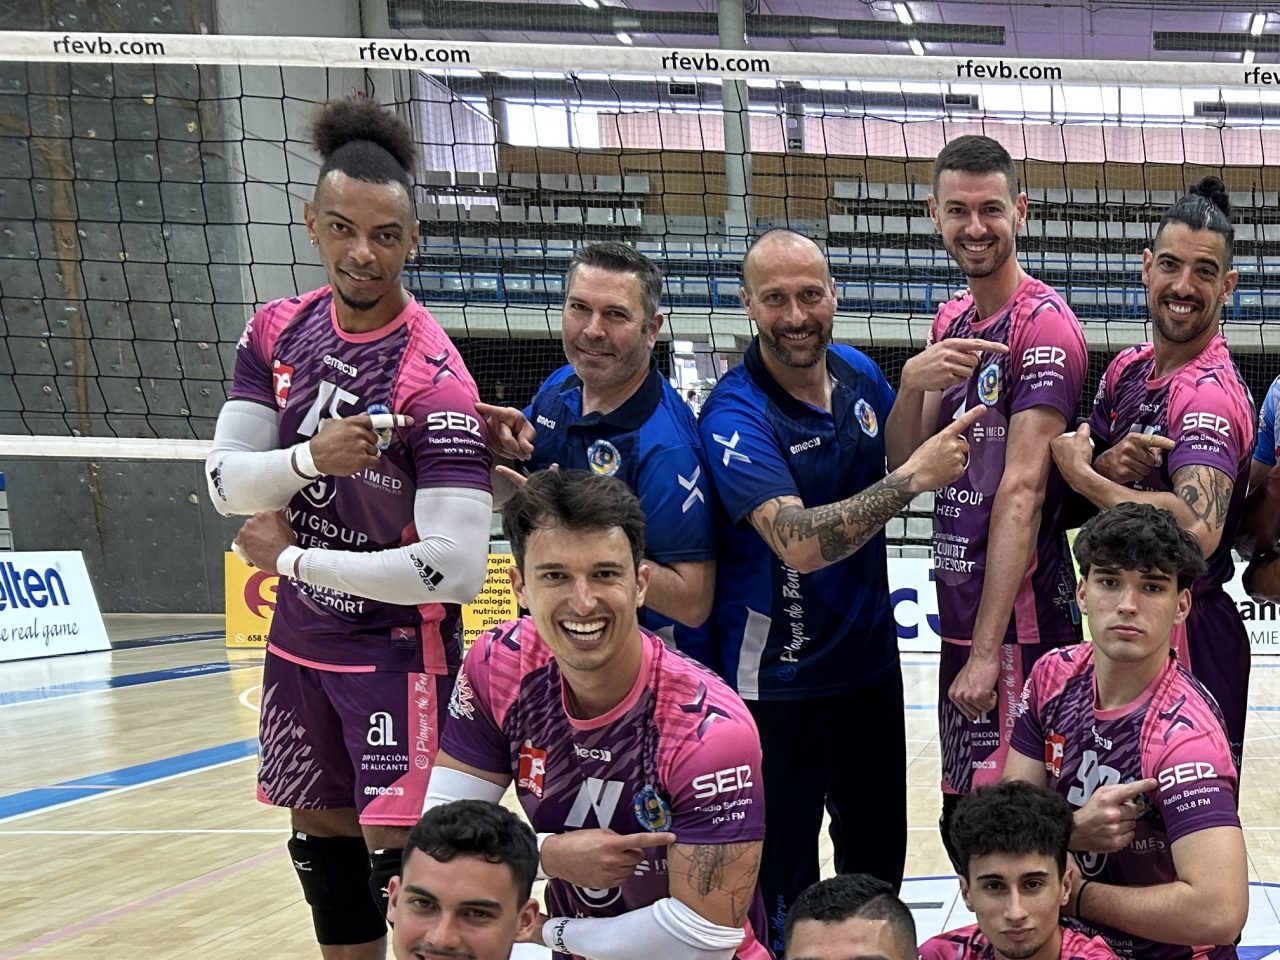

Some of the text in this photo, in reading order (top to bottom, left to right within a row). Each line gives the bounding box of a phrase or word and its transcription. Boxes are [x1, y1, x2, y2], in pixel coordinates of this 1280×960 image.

[53, 36, 165, 56] rfevb.com
[358, 43, 471, 65] rfevb.com
[661, 52, 771, 72] rfevb.com
[956, 61, 1062, 80] rfevb.com
[1022, 346, 1066, 367] SER
[427, 411, 481, 437] SER
[1182, 412, 1231, 437] SER
[429, 437, 450, 445] Radio
[1209, 445, 1220, 454] FM
[364, 469, 402, 490] IMED
[410, 553, 436, 592] adidas
[11, 618, 38, 639] real
[41, 621, 79, 646] game
[247, 634, 262, 642] 658
[416, 695, 429, 710] de
[416, 710, 431, 753] Playas
[370, 763, 409, 771] ALICANTE
[1157, 762, 1218, 791] SER
[692, 764, 753, 799] SER
[1163, 786, 1220, 806] Radio Benidorm
[1176, 797, 1211, 813] 103.8 FM
[731, 811, 746, 820] FM
